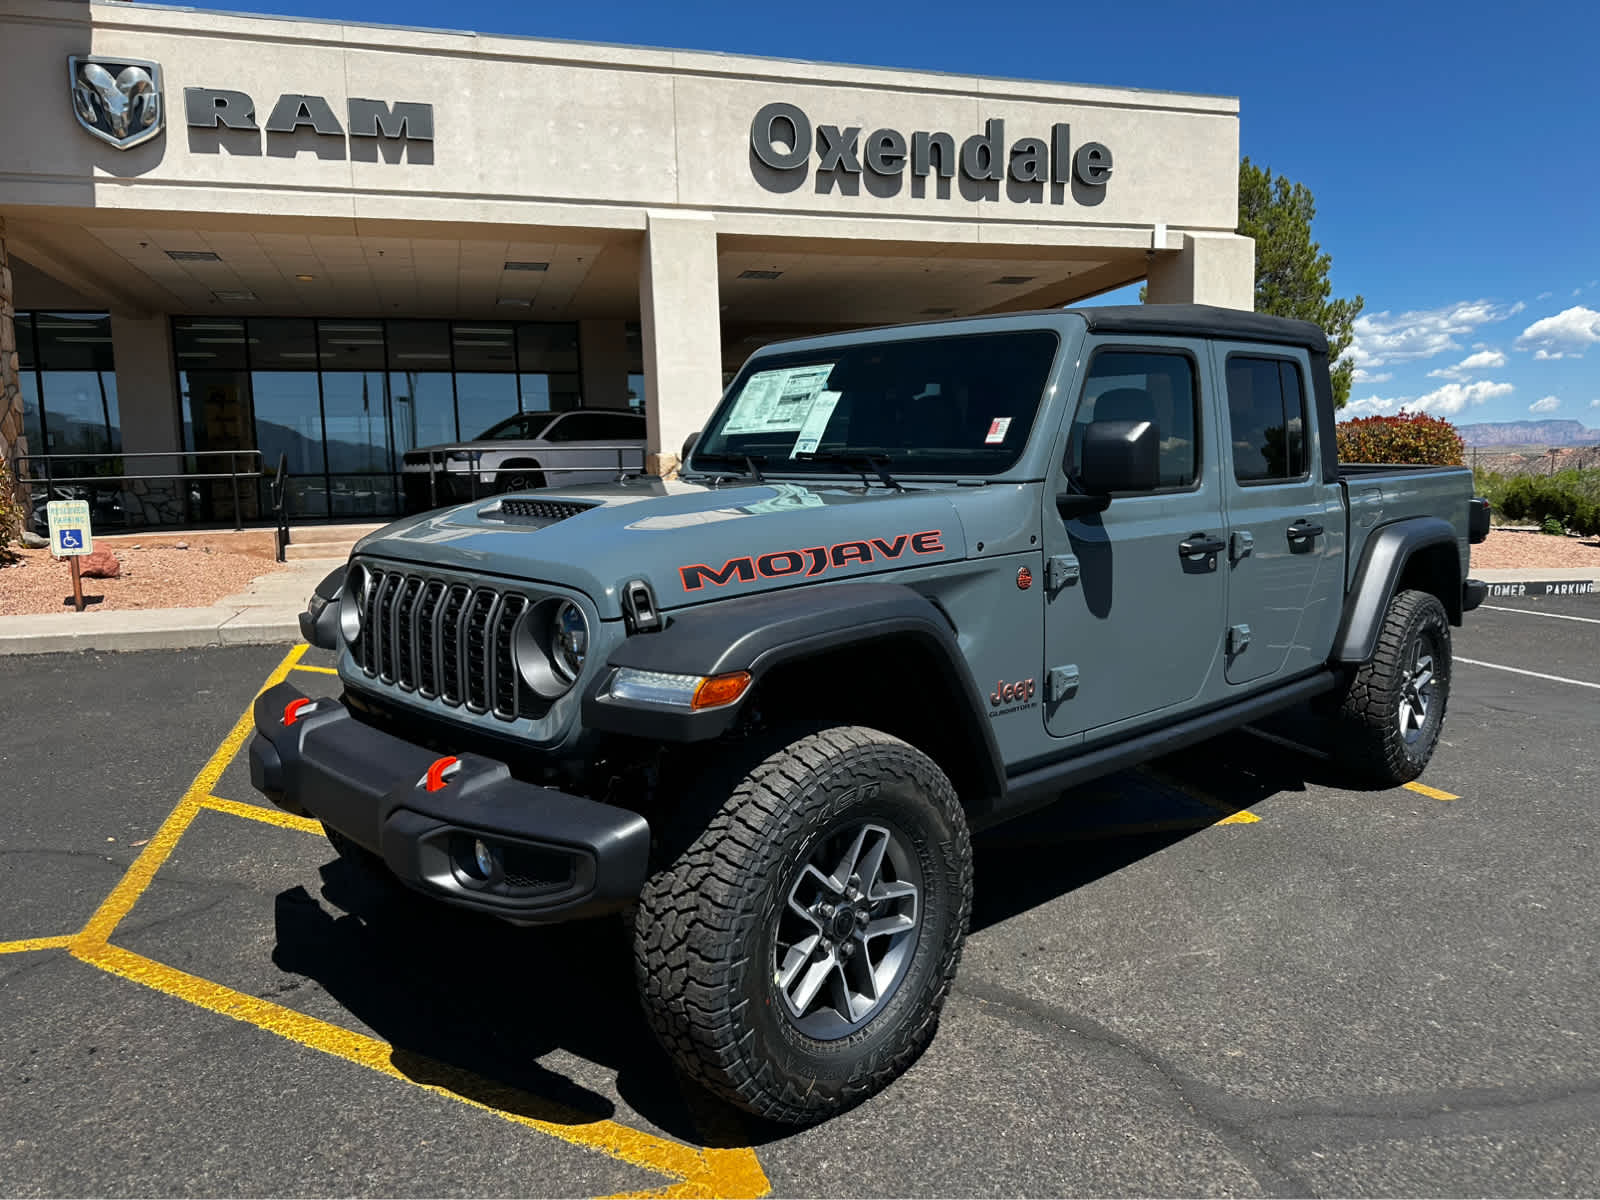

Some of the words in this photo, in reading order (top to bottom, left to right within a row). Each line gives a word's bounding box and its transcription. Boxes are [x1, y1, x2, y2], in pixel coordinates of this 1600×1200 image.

[184, 87, 434, 141] RAM
[751, 102, 1113, 185] Oxendale
[679, 530, 944, 592] MOJAVE
[1546, 583, 1593, 595] PARKING
[990, 679, 1035, 707] Jeep
